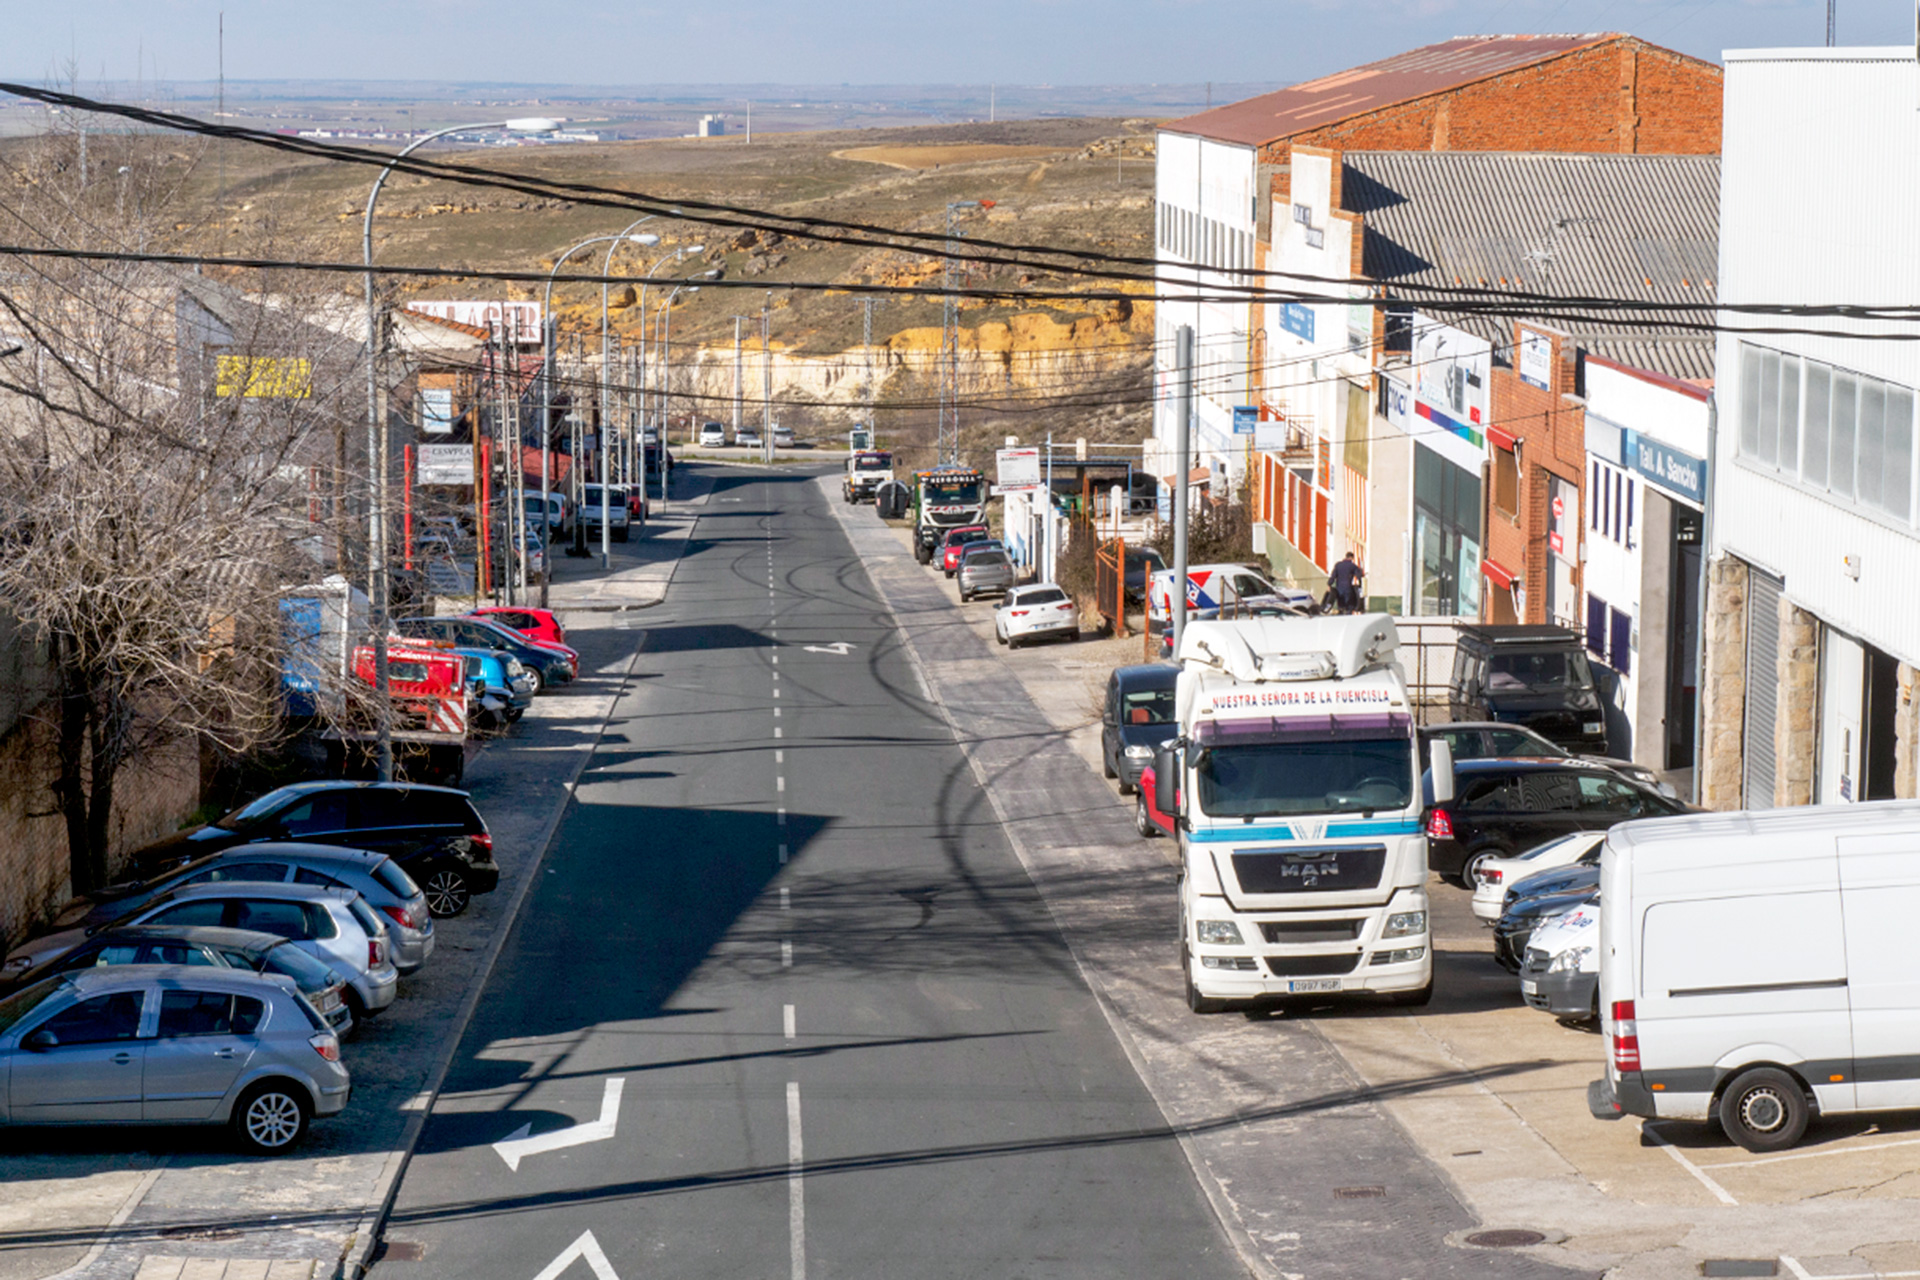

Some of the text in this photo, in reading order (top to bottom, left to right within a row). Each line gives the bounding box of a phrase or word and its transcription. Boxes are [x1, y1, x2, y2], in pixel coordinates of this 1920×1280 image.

[412, 305, 537, 339] AGER
[1656, 451, 1666, 477] A.
[1666, 454, 1698, 492] Sancho
[1212, 689, 1390, 709] NUESTRA SEÑORA DE LA FUENCISLA
[1280, 863, 1340, 877] MAN
